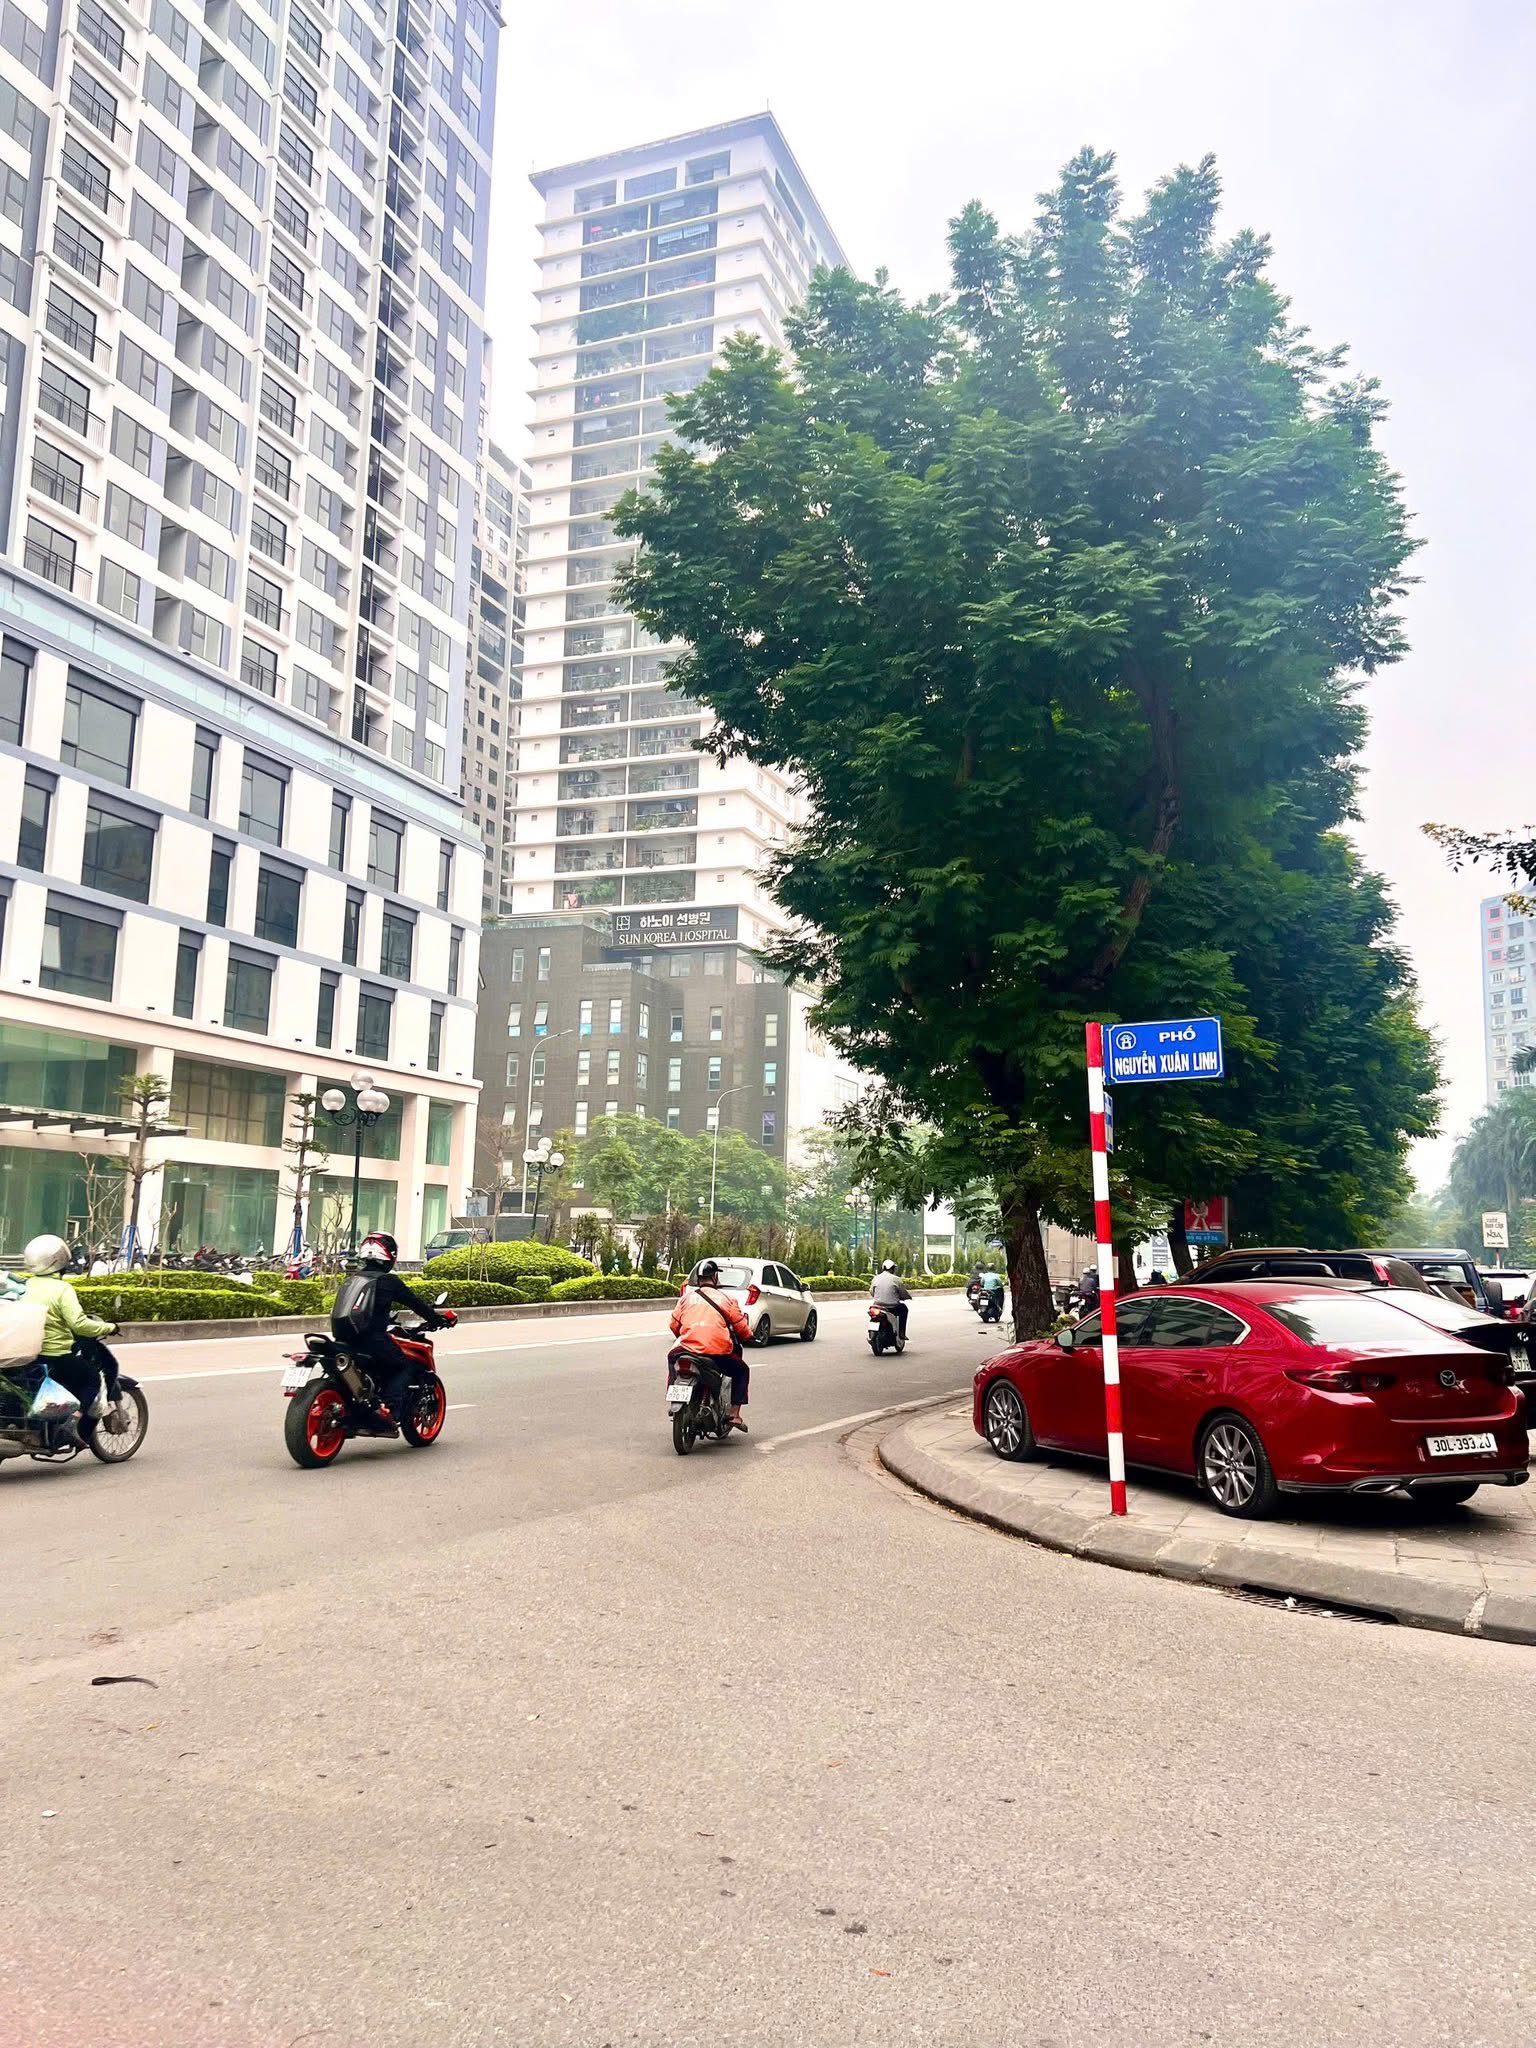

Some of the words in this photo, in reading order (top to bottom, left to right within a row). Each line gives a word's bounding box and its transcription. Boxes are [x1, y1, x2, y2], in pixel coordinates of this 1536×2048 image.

[640, 914, 673, 929] 하노이
[677, 911, 711, 926] 선병원
[618, 933, 640, 945] SUN
[643, 932, 677, 944] KOREA
[680, 929, 731, 941] HOSPITAL
[1159, 1024, 1196, 1043] PHỐ
[1114, 1050, 1157, 1076] NGUYỄN
[1160, 1050, 1190, 1073] XUÂN
[1192, 1051, 1218, 1071] LINH
